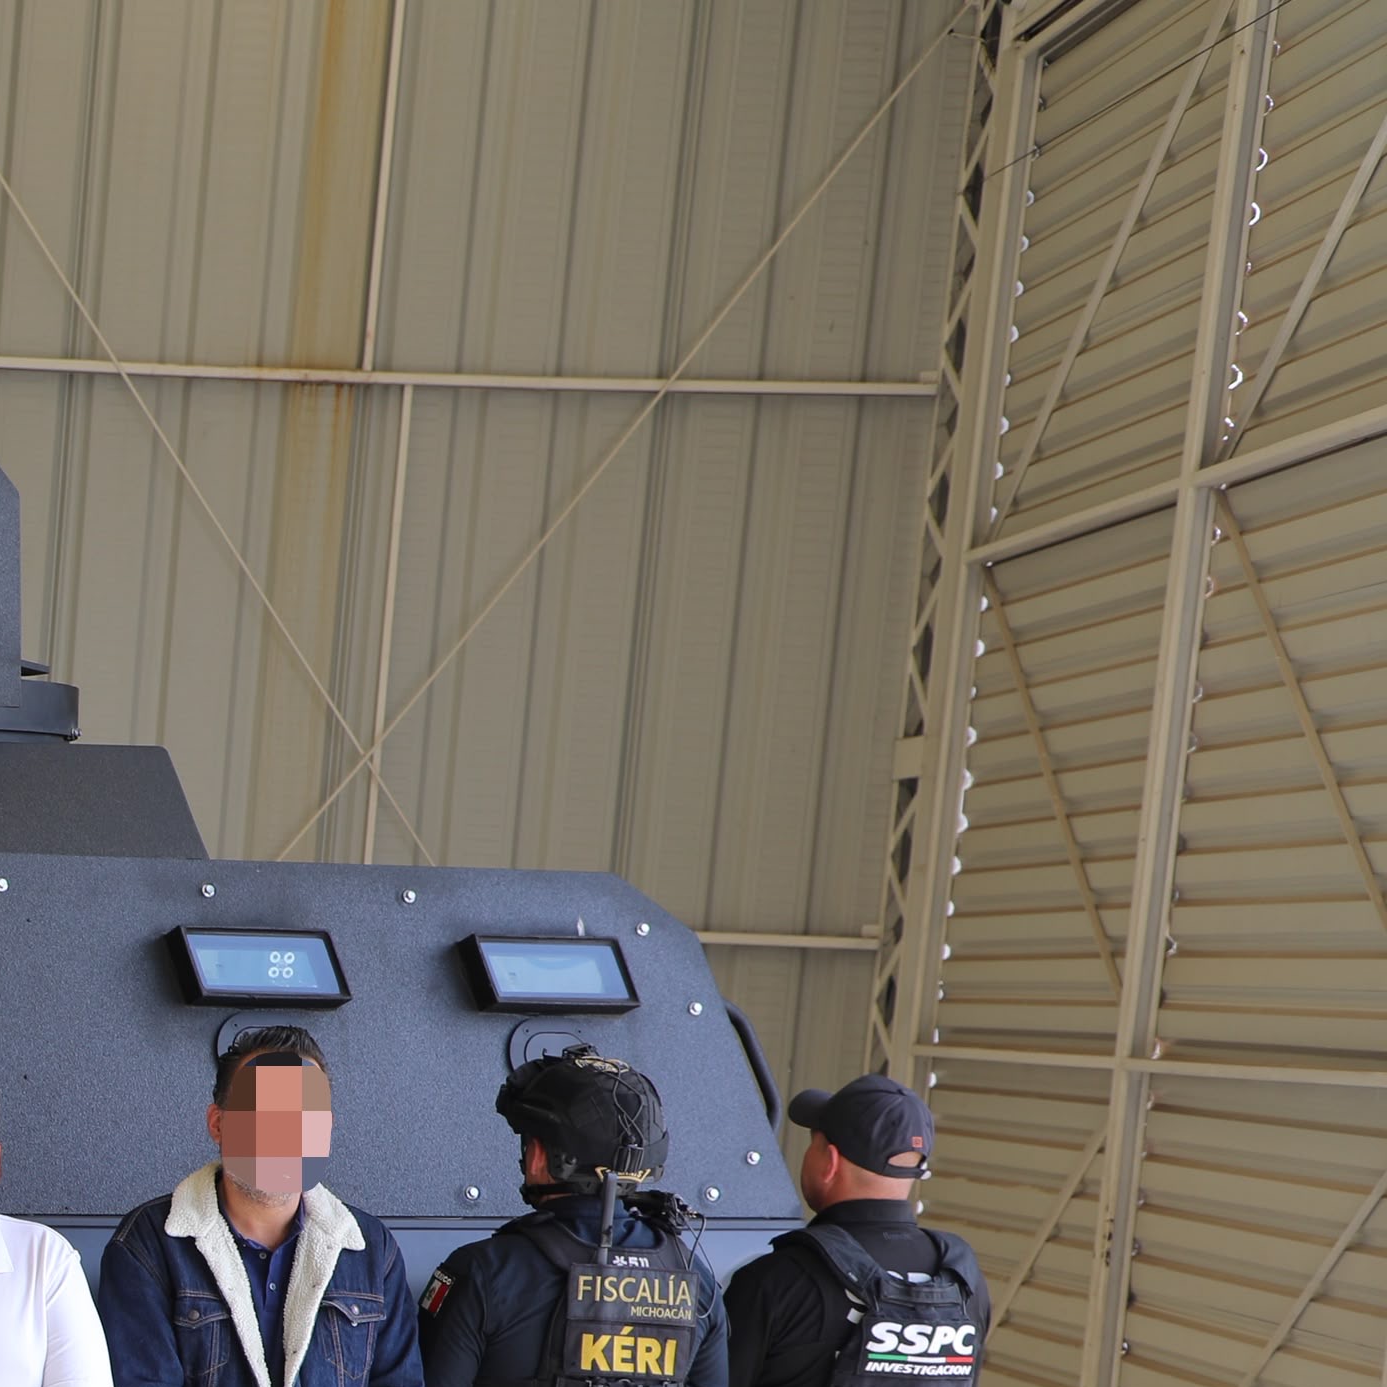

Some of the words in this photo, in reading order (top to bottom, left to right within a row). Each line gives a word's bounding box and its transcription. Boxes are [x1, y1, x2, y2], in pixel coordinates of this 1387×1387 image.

[577, 1275, 692, 1306] FISCALÍA
[630, 1306, 692, 1320] MICHOACÁN
[580, 1325, 677, 1376] KÉRI
[866, 1321, 976, 1355] SSPC
[865, 1361, 973, 1376] INVESTIGACION
